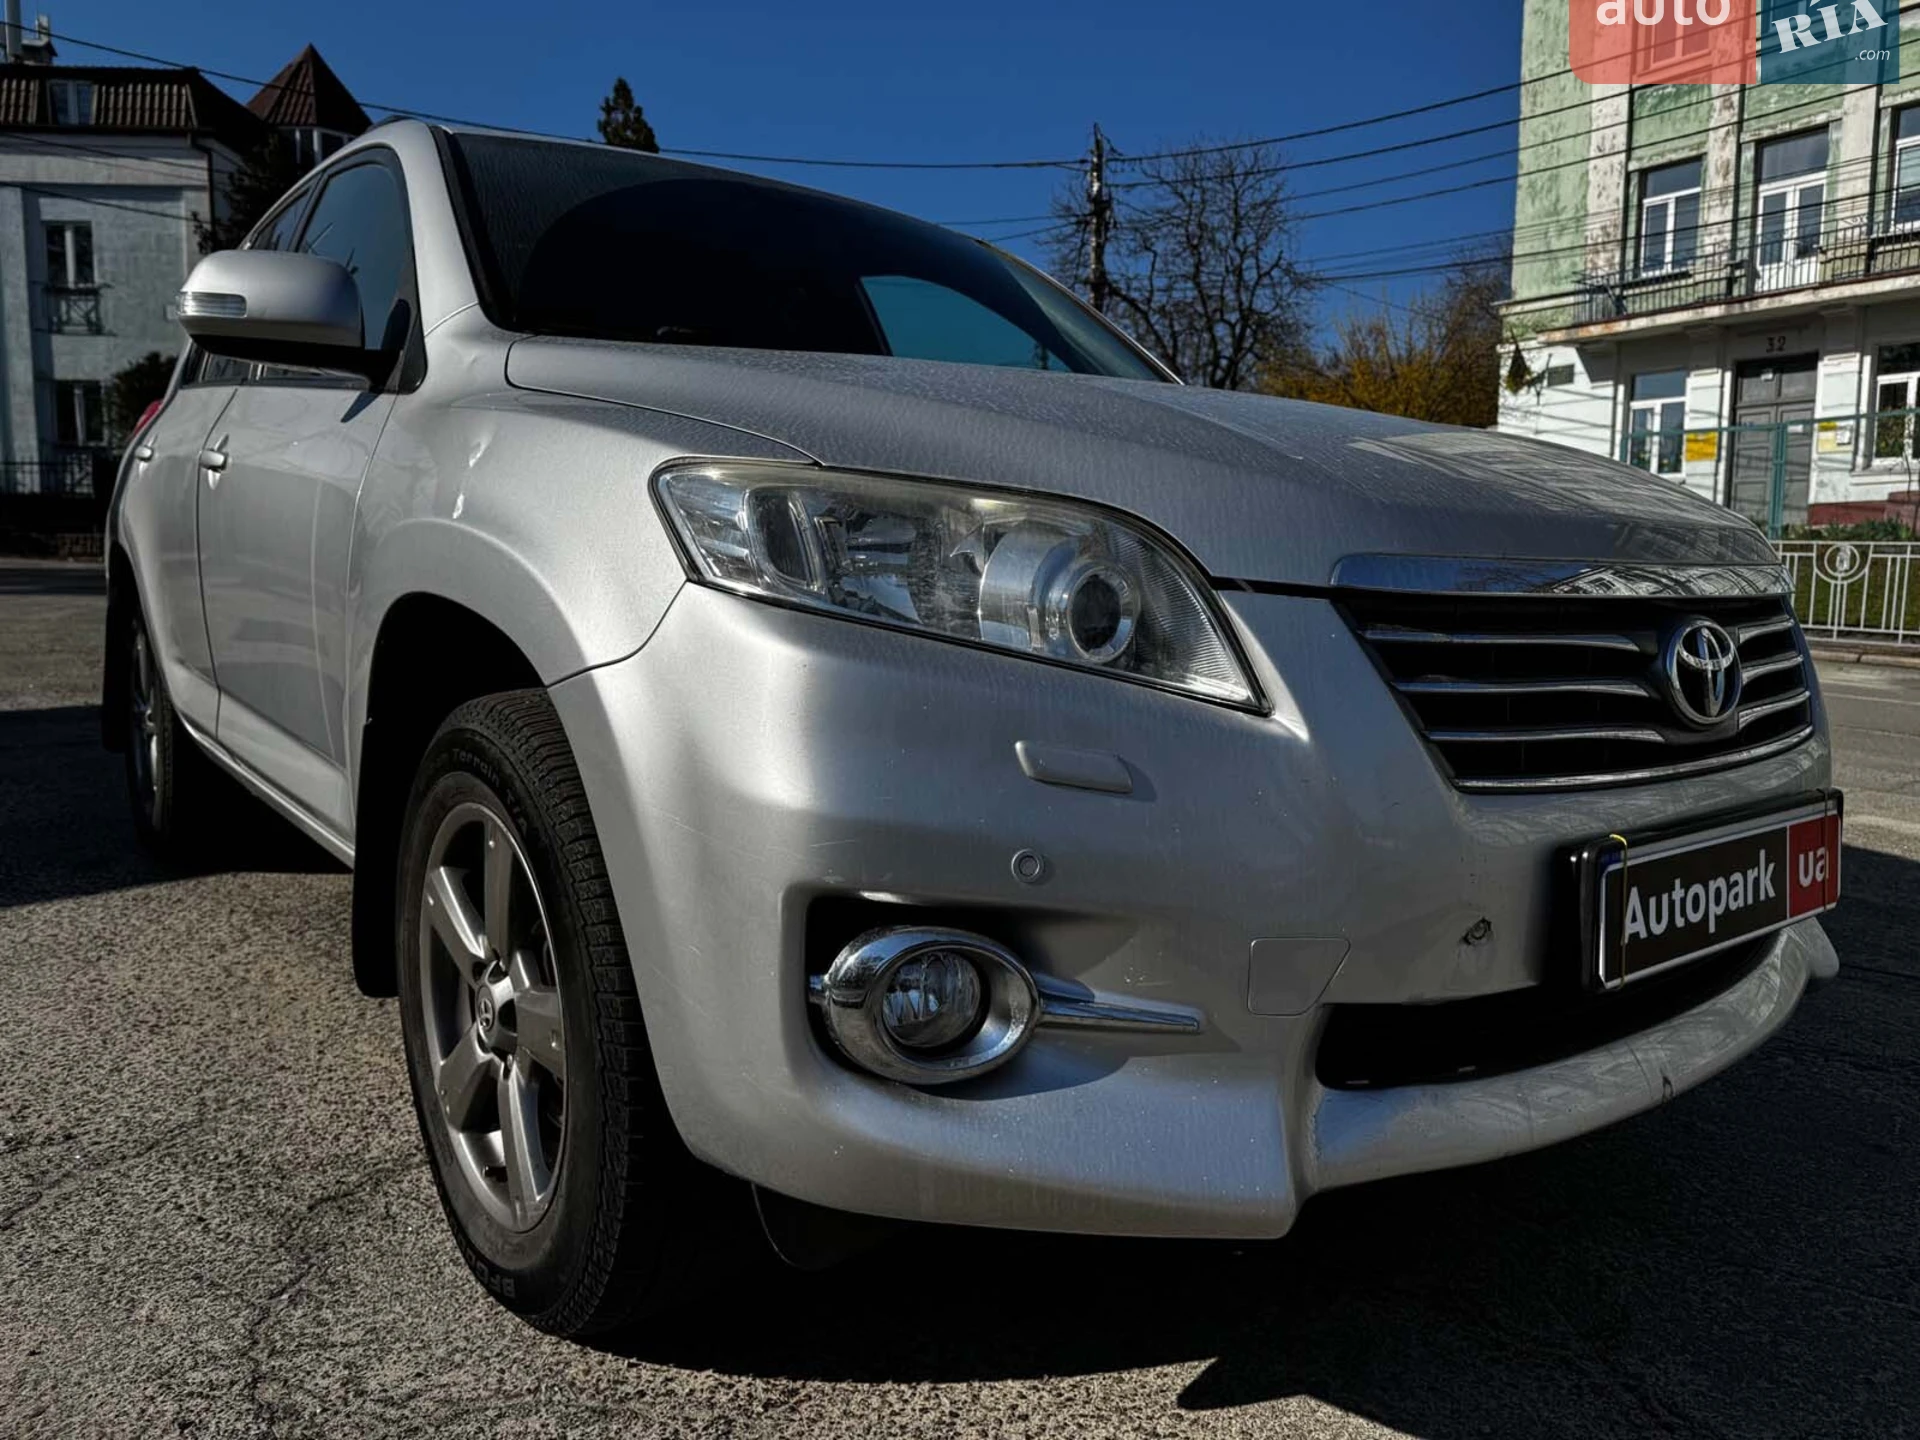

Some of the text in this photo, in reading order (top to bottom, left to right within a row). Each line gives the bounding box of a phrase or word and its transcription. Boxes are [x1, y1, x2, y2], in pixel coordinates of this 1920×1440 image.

[1766, 337, 1786, 352] 32
[1623, 847, 1830, 945] Autopark ua
